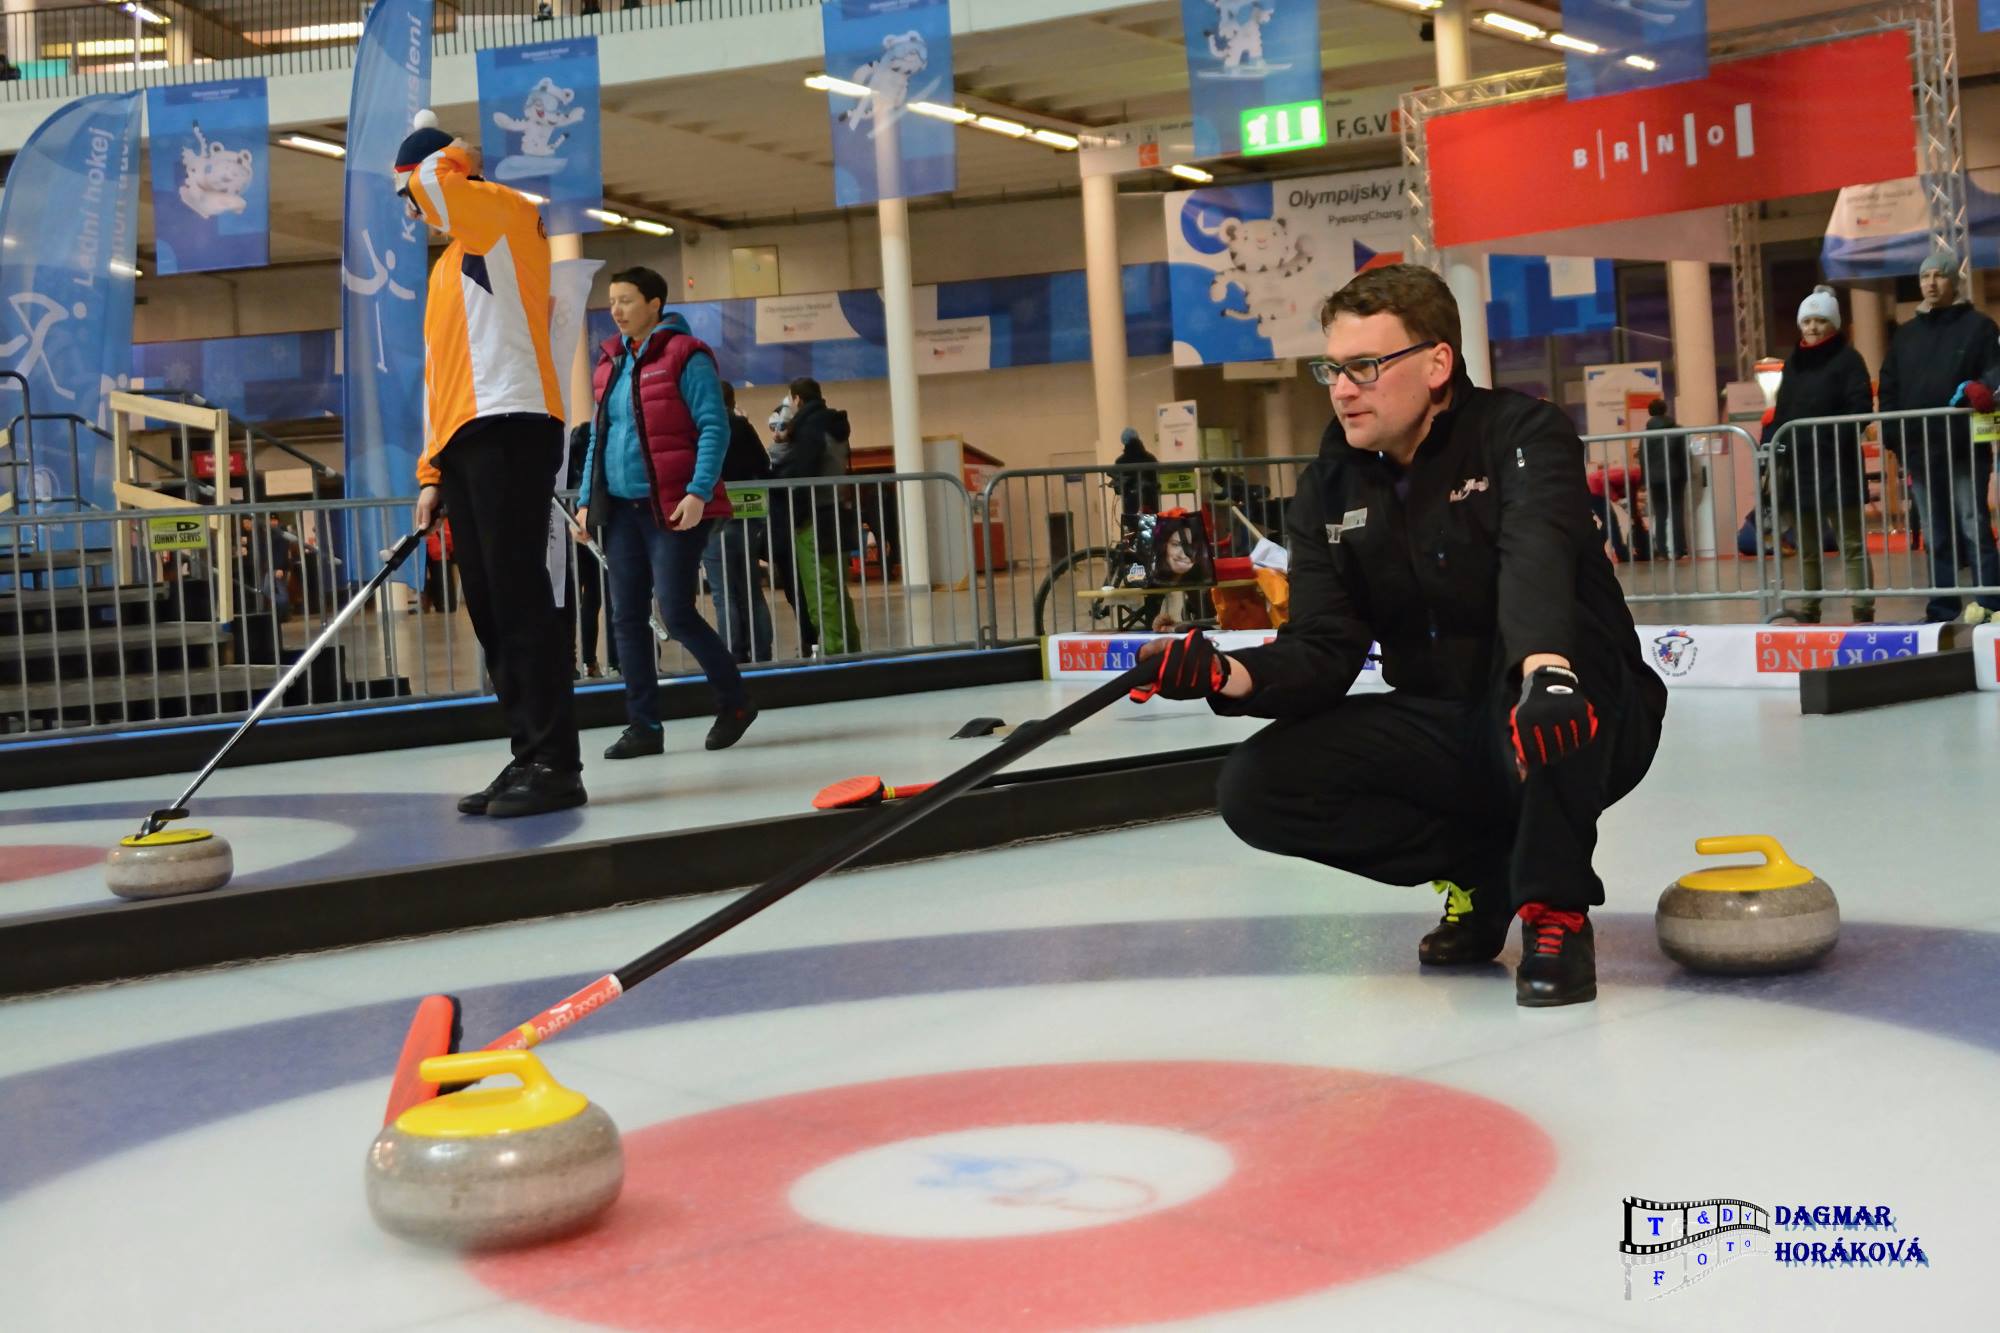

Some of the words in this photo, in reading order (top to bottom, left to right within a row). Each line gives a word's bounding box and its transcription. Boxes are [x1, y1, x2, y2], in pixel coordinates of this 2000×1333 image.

[83, 127, 114, 202] hokej
[1289, 181, 1393, 209] Olympijský
[1328, 208, 1404, 225] PyeongChang
[1062, 639, 1130, 650] ROMO
[1762, 632, 1914, 645] PROMO
[1062, 652, 1137, 669] URLING
